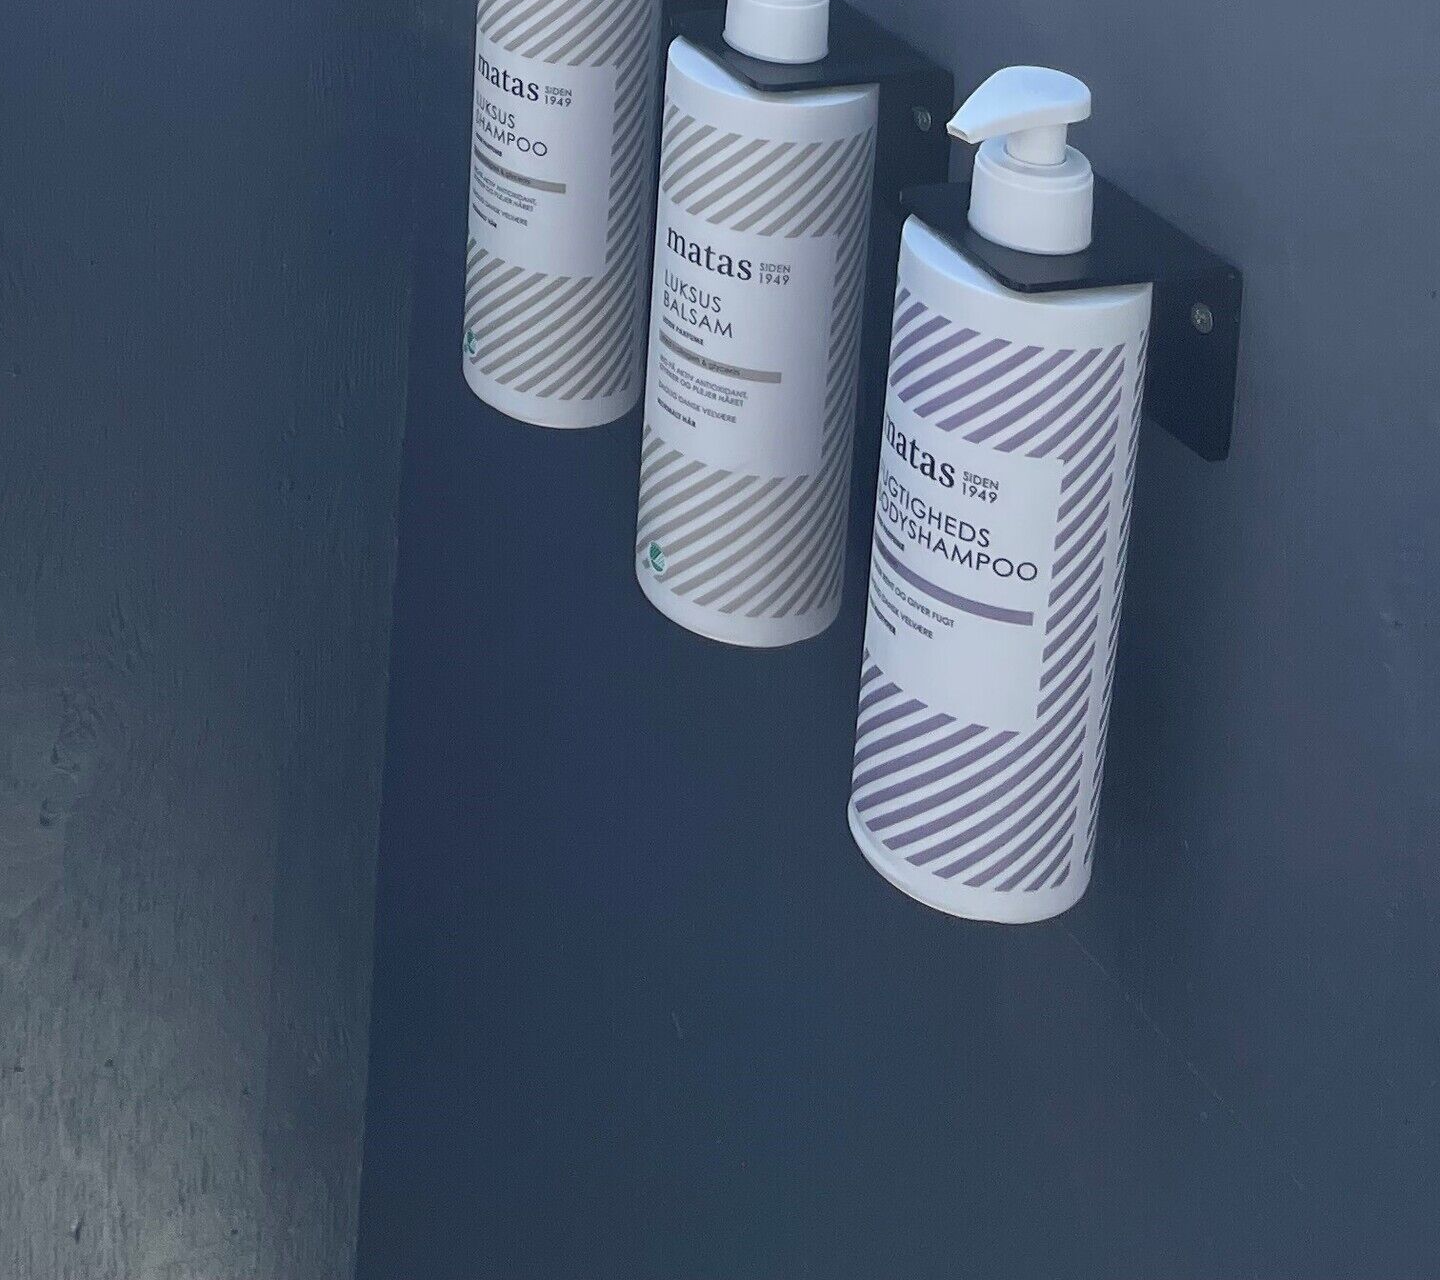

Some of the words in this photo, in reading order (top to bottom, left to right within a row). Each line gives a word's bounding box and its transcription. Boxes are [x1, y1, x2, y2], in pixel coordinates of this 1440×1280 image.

[478, 53, 539, 101] matas
[544, 86, 573, 97] SIDEN
[476, 90, 516, 129] LUKSUS
[544, 95, 572, 107] 1949
[667, 226, 752, 281] matas
[759, 262, 791, 274] SIDEN
[664, 269, 722, 313] LUKSUS
[759, 273, 791, 286] 1949
[663, 290, 733, 339] BALSAM
[962, 470, 1000, 491] SIDEN
[962, 483, 998, 504] 1949
[881, 462, 991, 548] UGTIGHEDS
